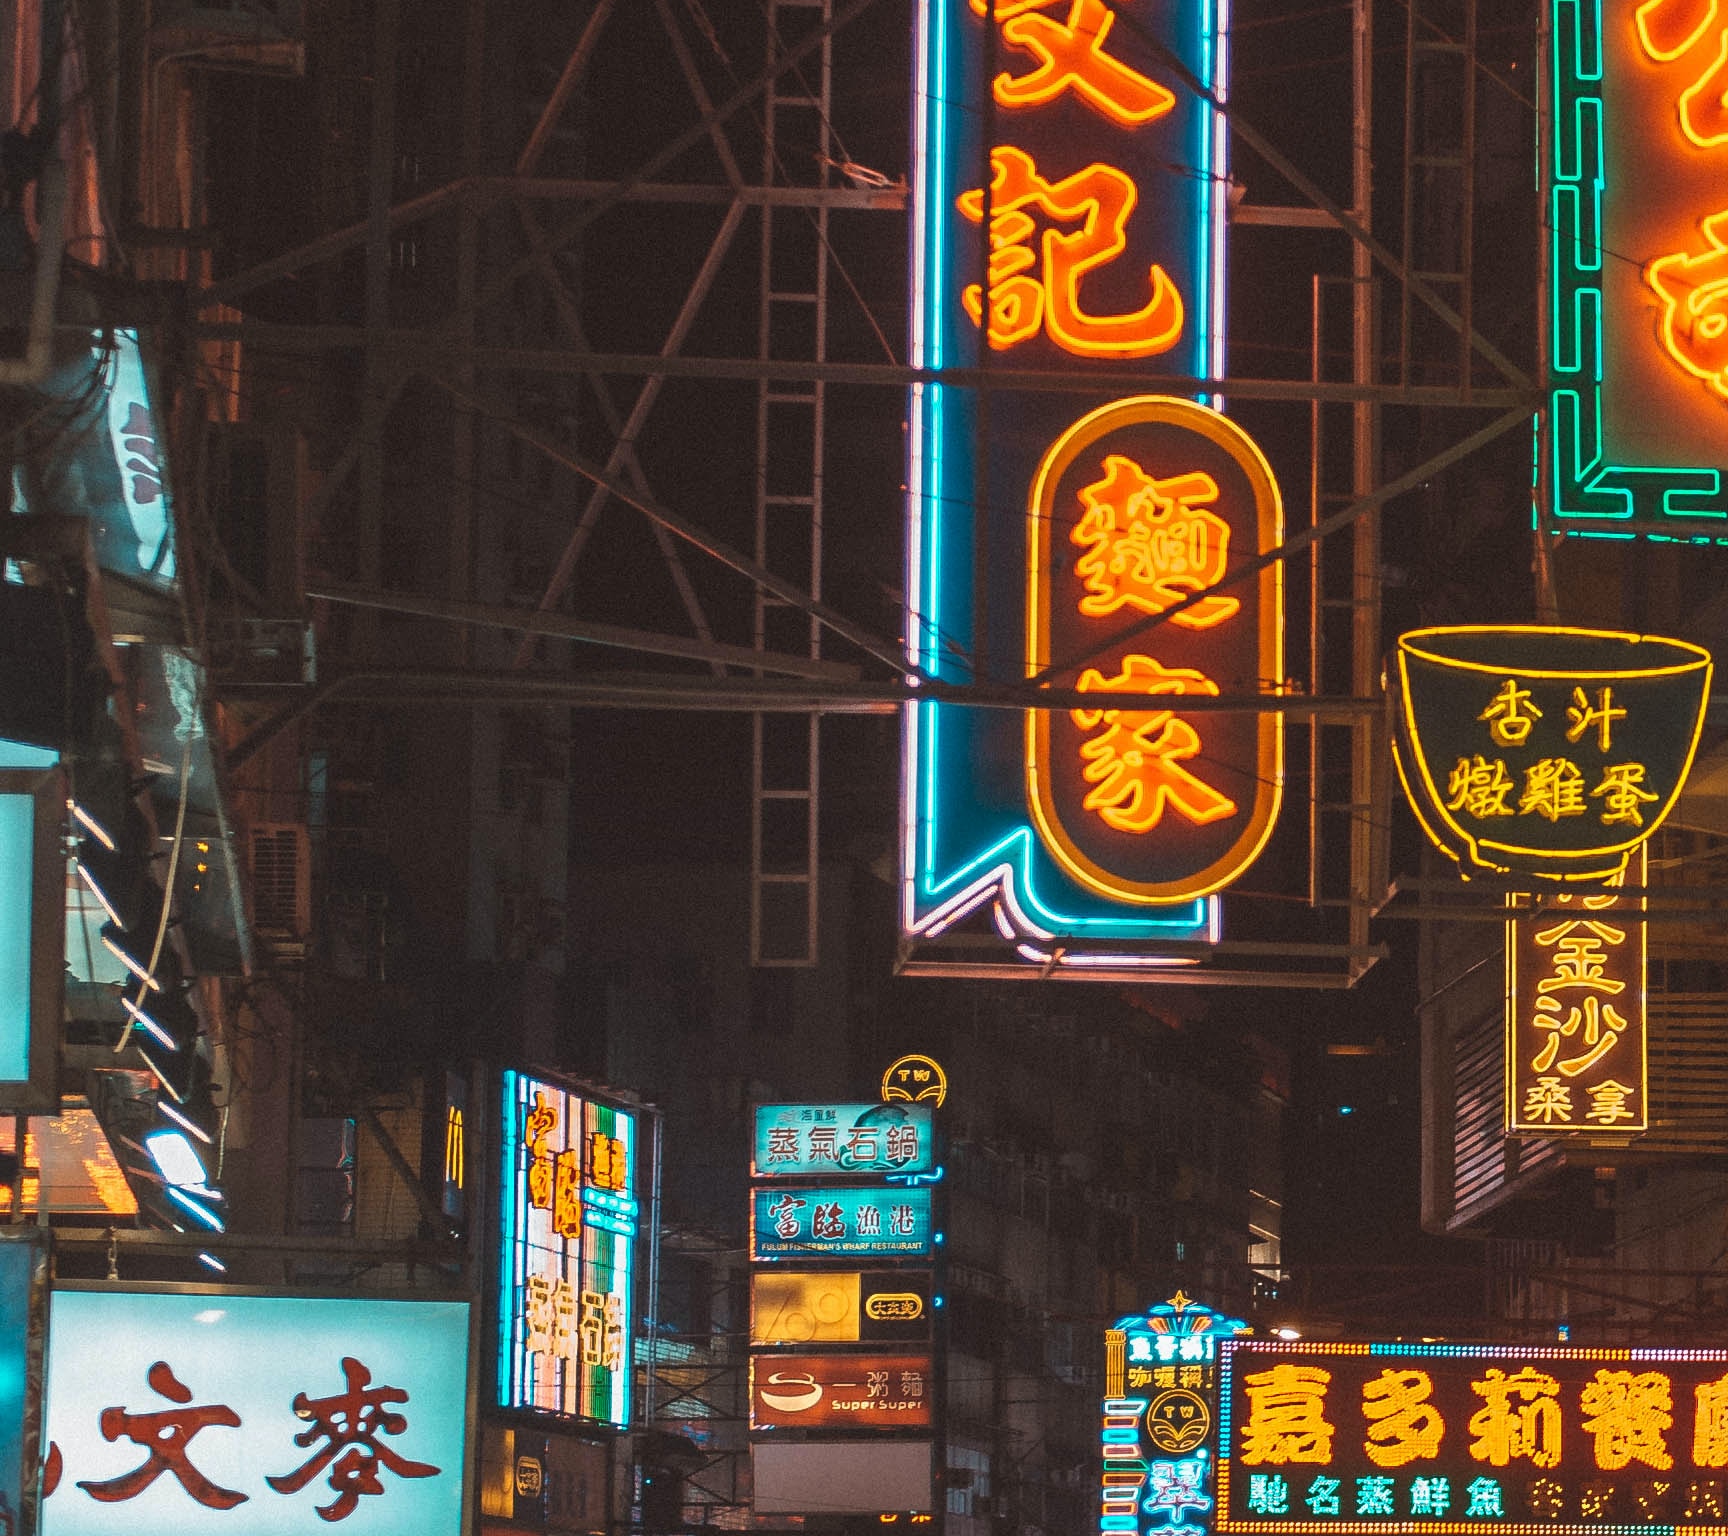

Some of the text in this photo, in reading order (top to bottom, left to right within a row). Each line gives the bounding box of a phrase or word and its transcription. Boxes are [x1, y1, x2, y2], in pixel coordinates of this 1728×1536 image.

[1478, 678, 1628, 753] 杏汁
[1447, 757, 1659, 827] 燉雞蛋
[1534, 872, 1627, 1073] 金沙
[1525, 1075, 1634, 1125] 桑拿
[768, 1125, 920, 1163] 蒸氣石鍋
[769, 1194, 916, 1240] 富臨漁港
[762, 1242, 788, 1251] FULUM
[842, 1242, 869, 1251] WHARF
[871, 1242, 923, 1251] RESTAURANT
[832, 1400, 923, 1410] Super Super
[1248, 1474, 1505, 1516] 馳名蒸鮮魚
